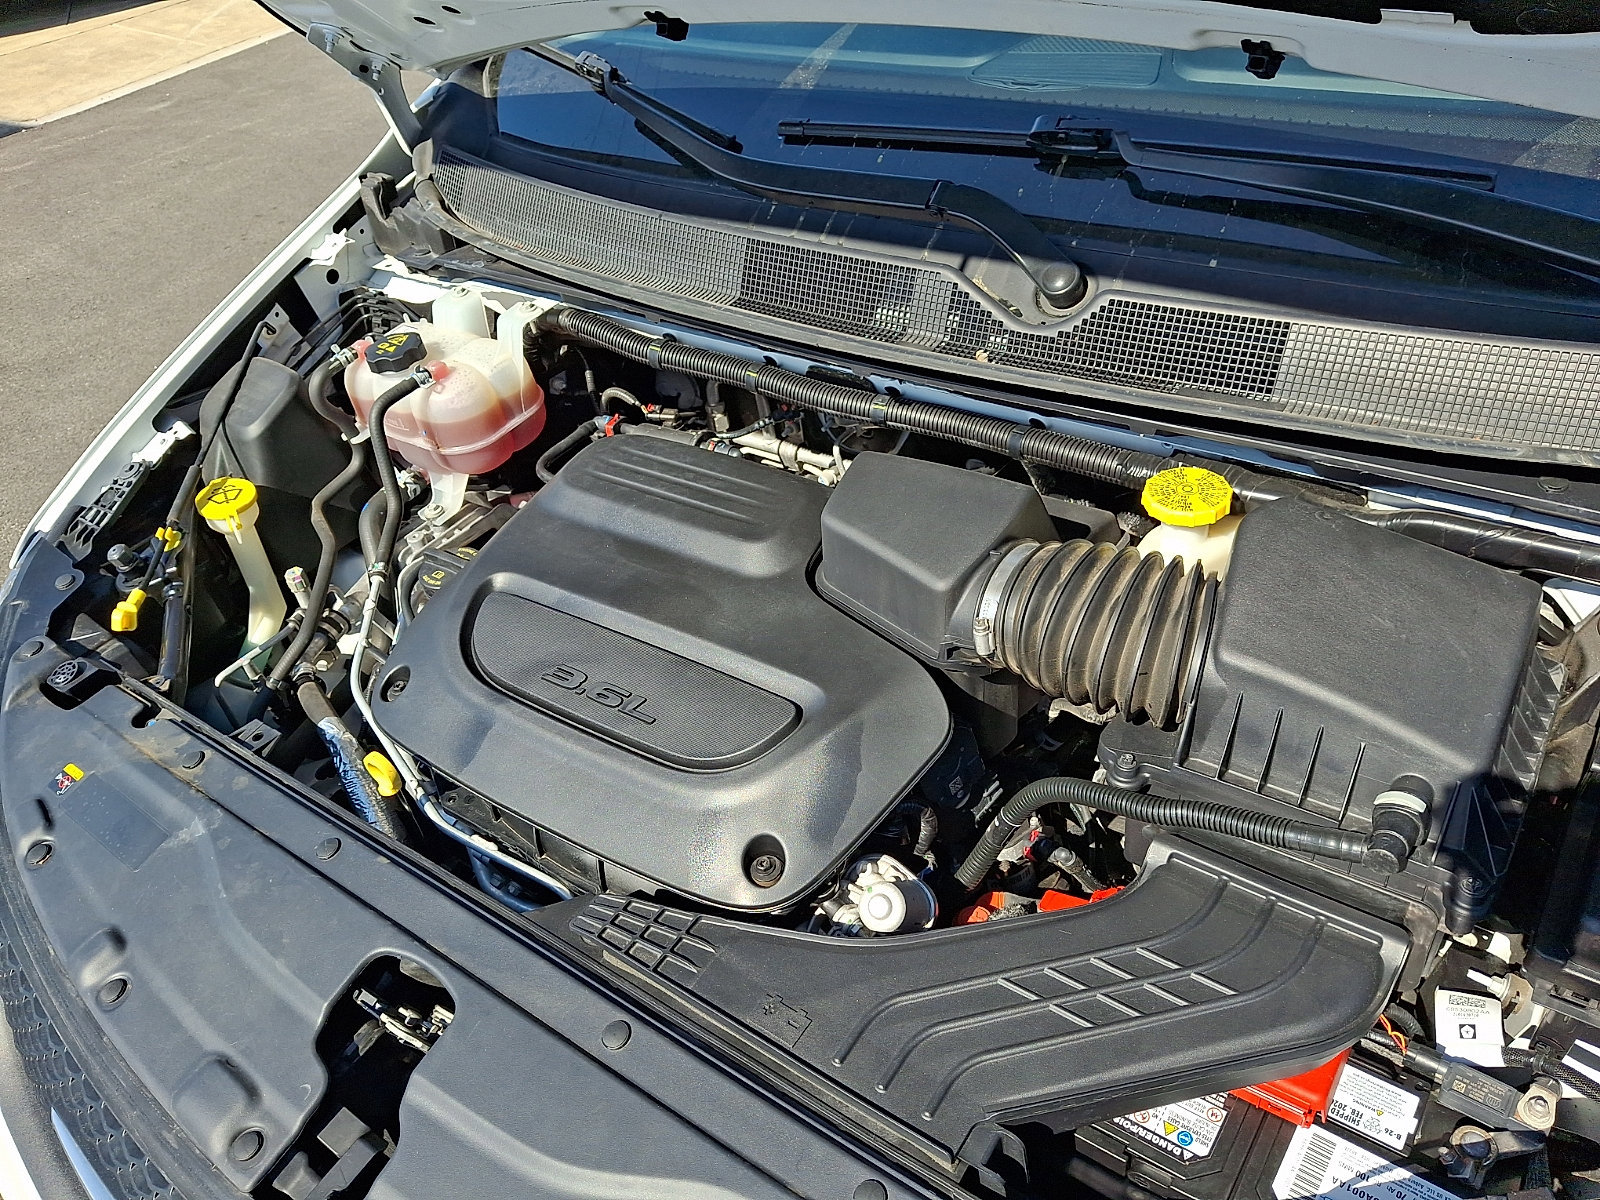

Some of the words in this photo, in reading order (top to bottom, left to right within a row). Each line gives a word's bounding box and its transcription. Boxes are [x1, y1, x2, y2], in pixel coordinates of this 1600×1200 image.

[540, 663, 657, 725] 3.6L
[1332, 1099, 1348, 1111] 202
[1331, 1107, 1360, 1126] SHIPPED
[1350, 1107, 1363, 1119] FEB.
[1384, 1127, 1401, 1140] B-26
[1355, 1170, 1369, 1181] 100
